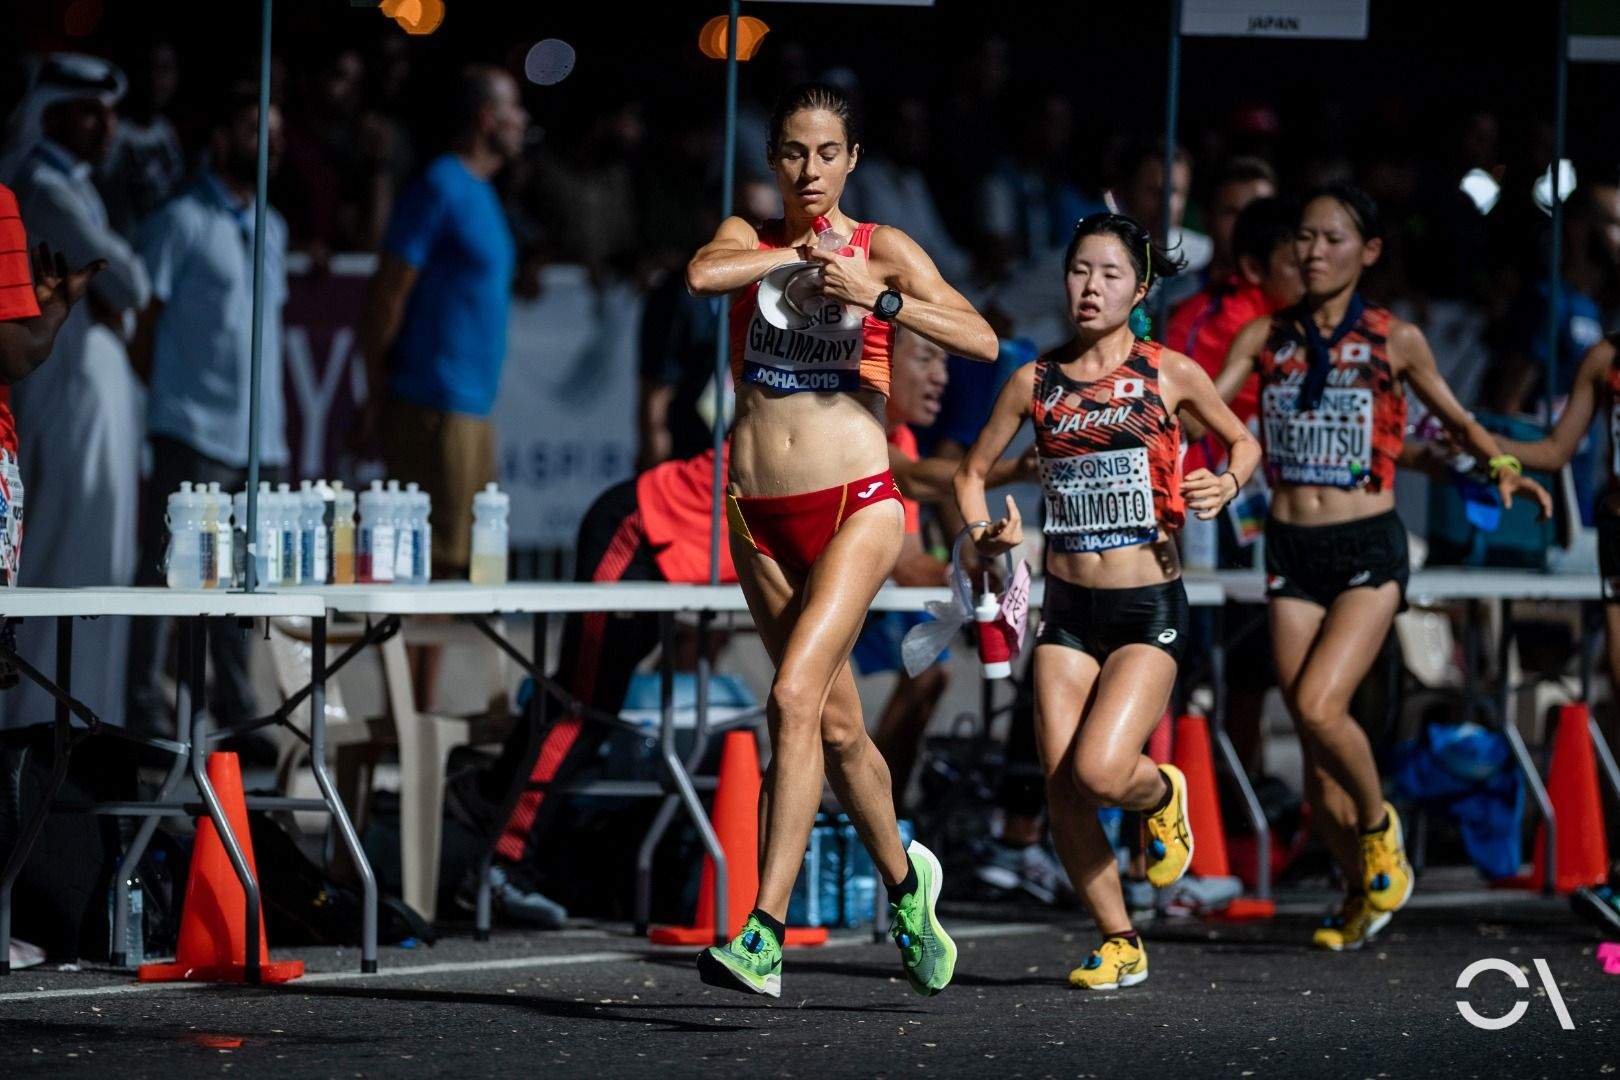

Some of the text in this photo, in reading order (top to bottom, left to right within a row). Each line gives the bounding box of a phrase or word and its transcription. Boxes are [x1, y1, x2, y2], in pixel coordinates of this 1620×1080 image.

[750, 318, 857, 364] GALIMANY
[1052, 405, 1133, 435] JAPAN
[1079, 456, 1131, 480] QNB
[1050, 490, 1147, 528] TANIMOTO
